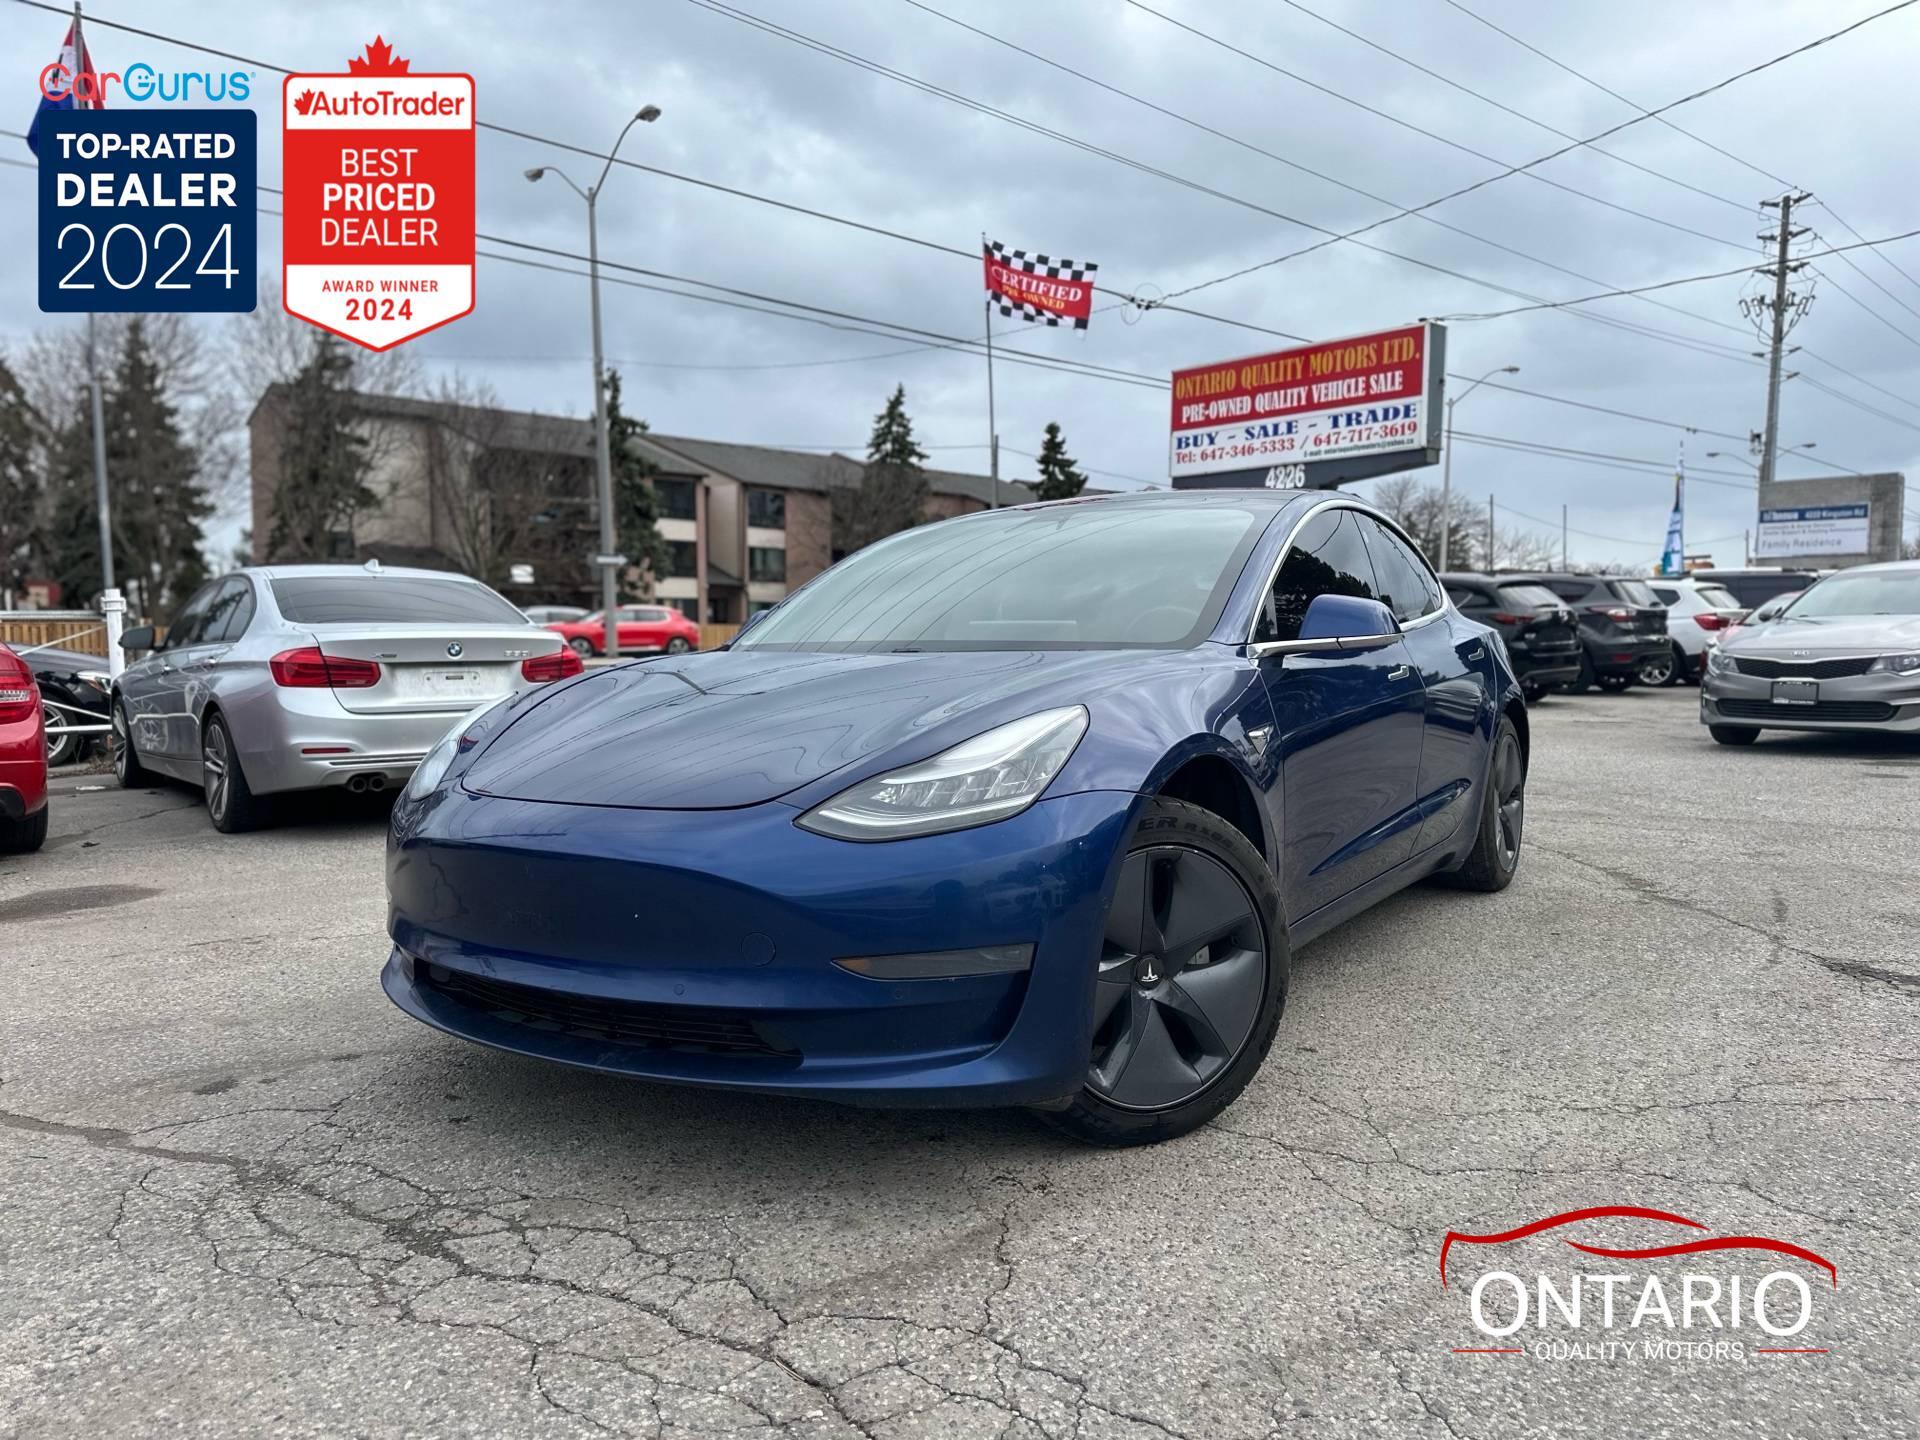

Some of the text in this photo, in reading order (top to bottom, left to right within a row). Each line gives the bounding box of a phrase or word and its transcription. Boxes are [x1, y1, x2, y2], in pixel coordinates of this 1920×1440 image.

[991, 266, 1082, 301] CERTIFIED
[1023, 292, 1064, 309] OWNED
[1176, 336, 1420, 400] ONTARIO QUALITY MOTORS LTD.
[1182, 370, 1403, 424] PRE-OWNED QUALITY VEHICLE SALE
[1176, 432, 1219, 450] BUY
[1245, 420, 1298, 441] SALE
[1328, 403, 1417, 429] TRADE
[1176, 451, 1196, 465] Tel:
[1200, 438, 1295, 462] 647-346-5333
[1314, 421, 1417, 448] 647-717-3619
[1265, 465, 1305, 489] 4226
